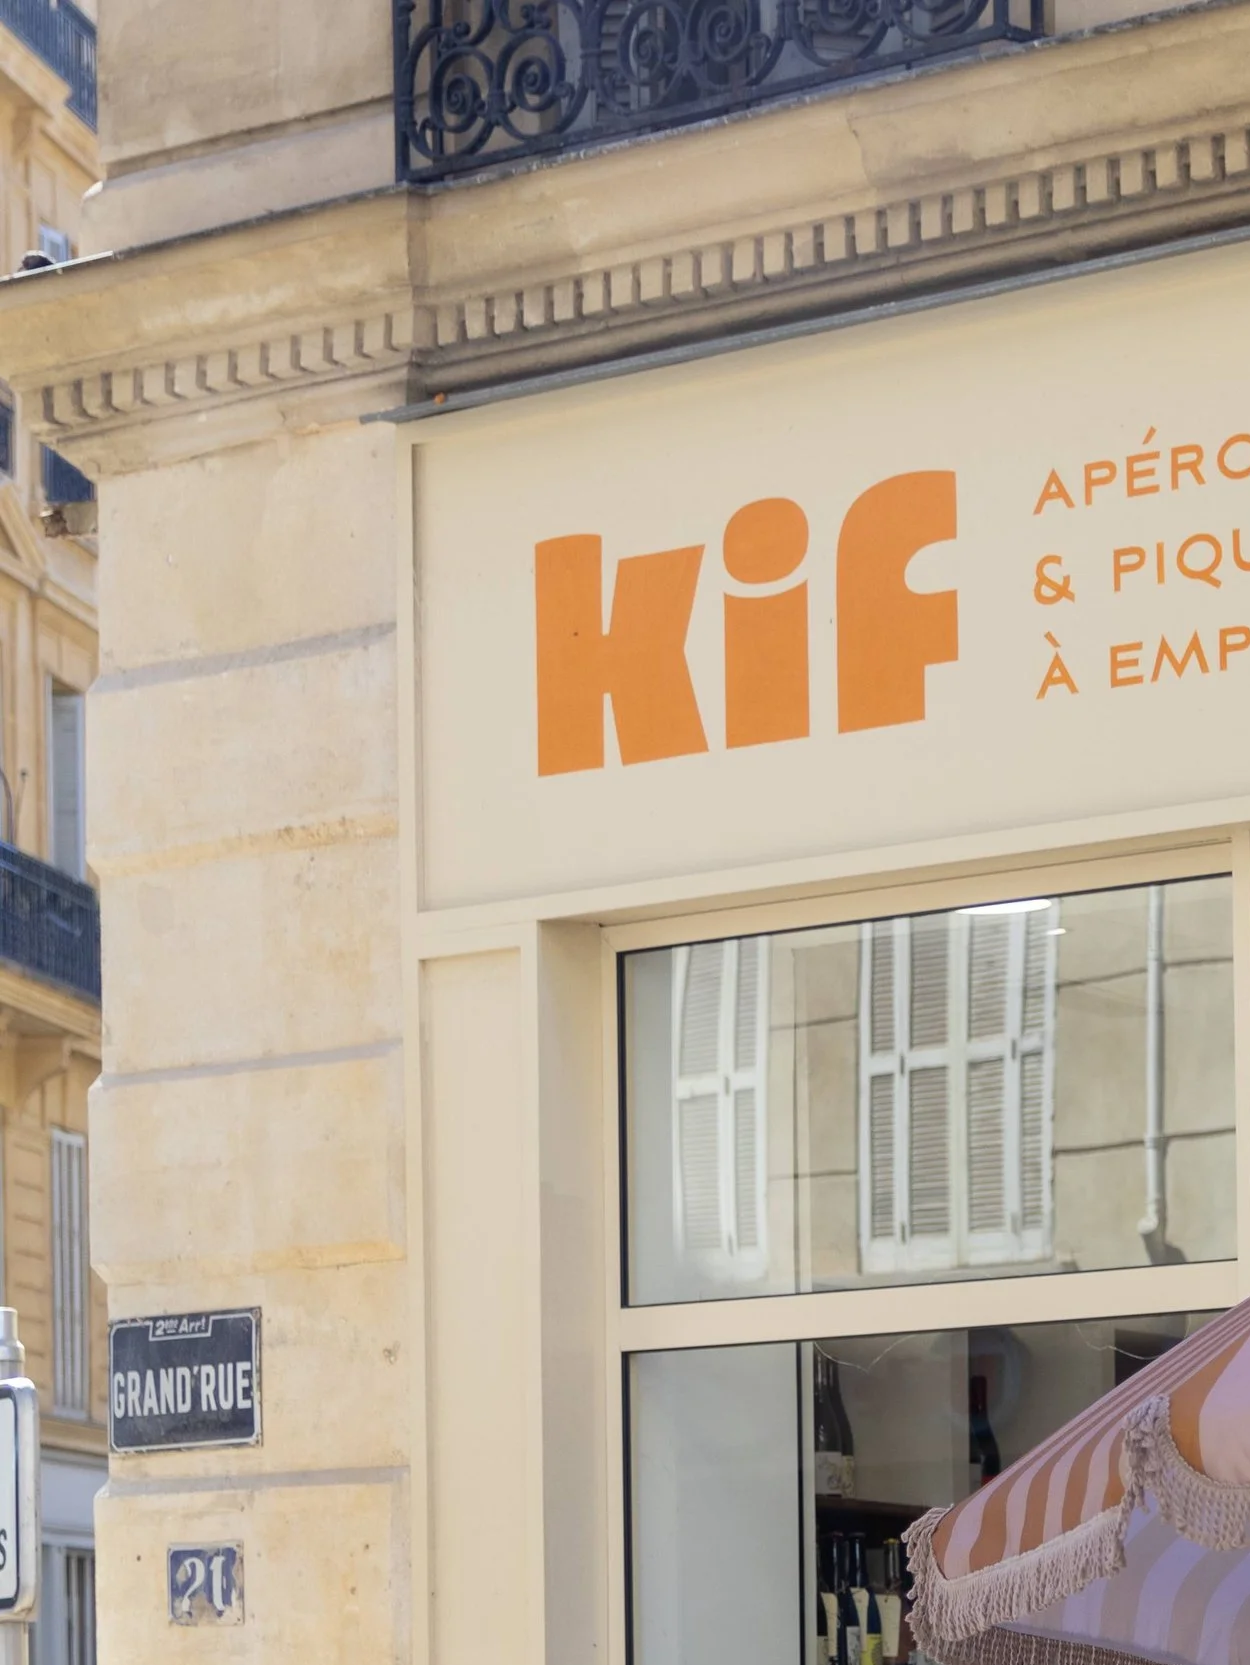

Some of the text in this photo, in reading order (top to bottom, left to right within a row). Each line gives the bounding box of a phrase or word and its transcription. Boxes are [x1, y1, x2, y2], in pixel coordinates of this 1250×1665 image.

[1034, 554, 1075, 606] &
[534, 469, 959, 777] kif
[1036, 631, 1078, 700] À
[113, 1361, 252, 1419] GRAND'RUE
